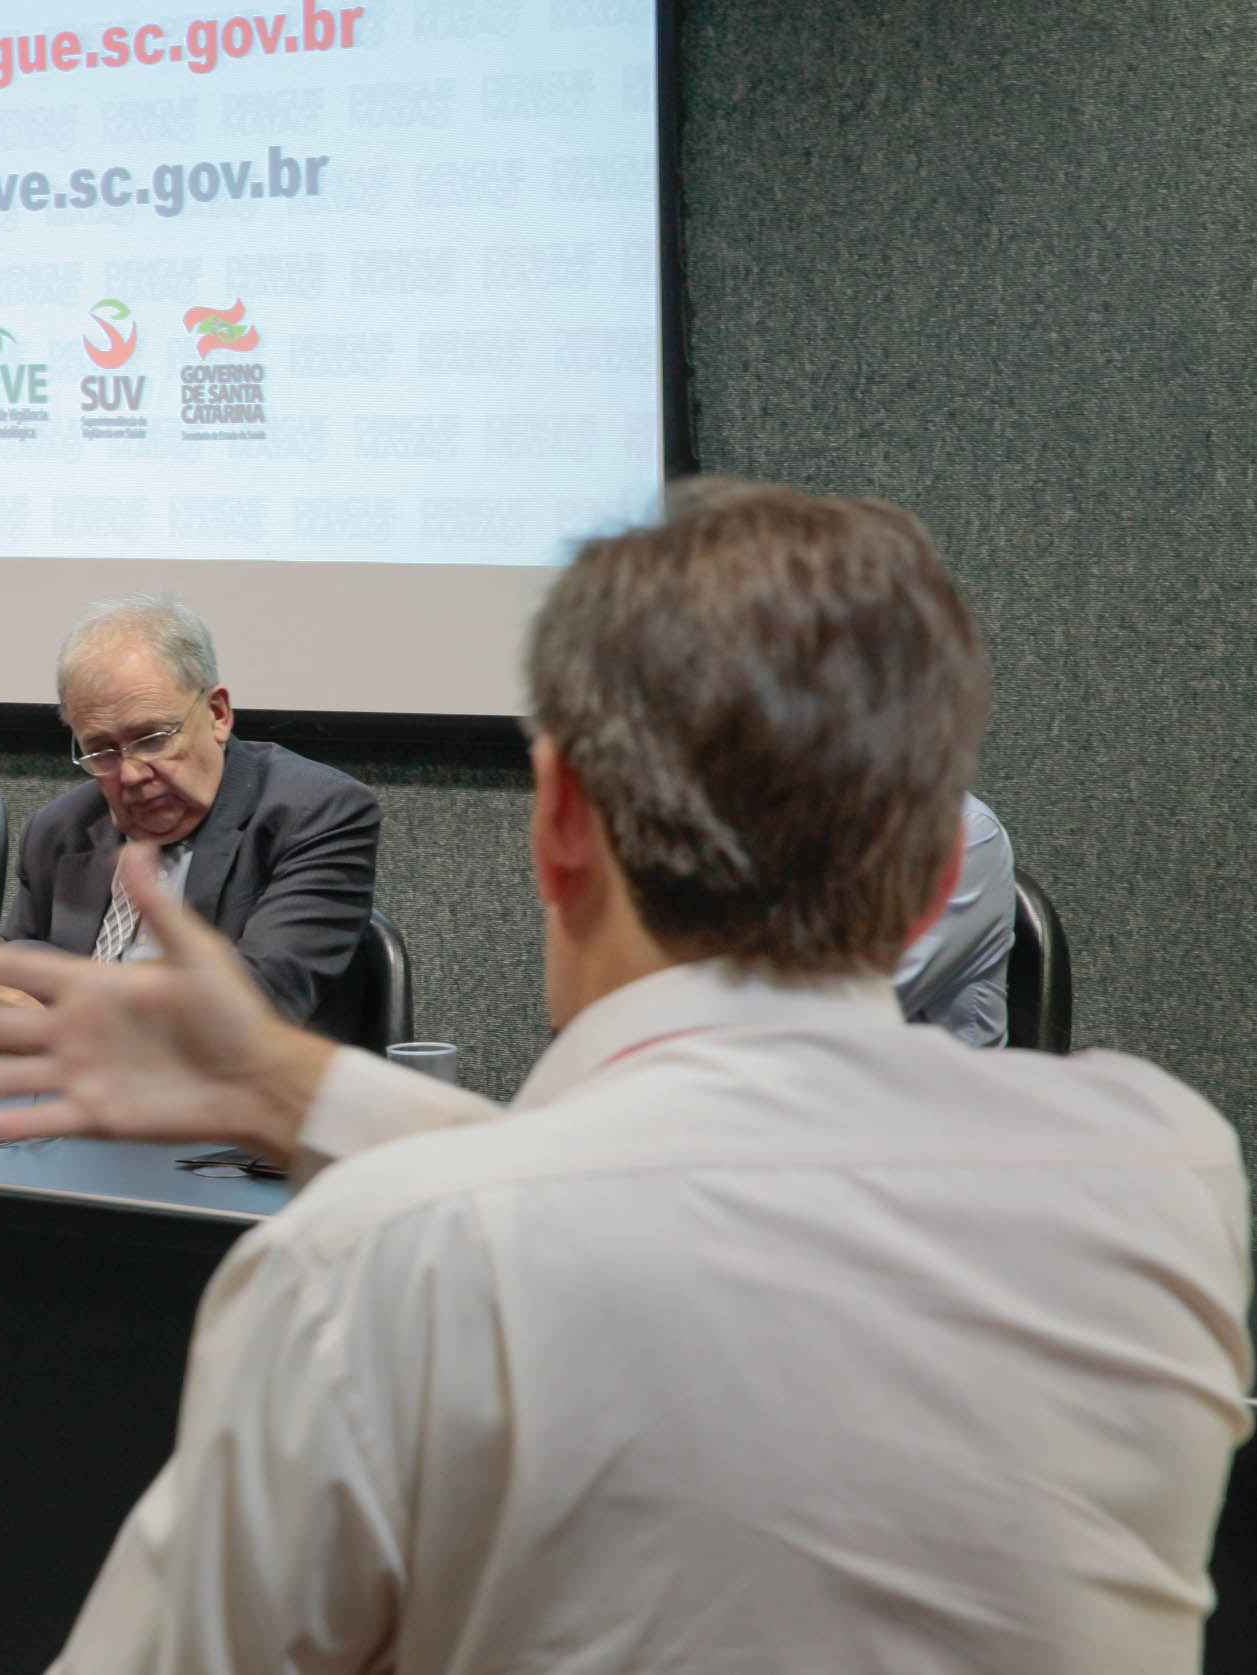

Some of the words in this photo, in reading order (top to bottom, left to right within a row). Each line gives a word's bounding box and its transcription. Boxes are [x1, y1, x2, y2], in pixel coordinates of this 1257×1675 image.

[181, 364, 264, 383] GOVERNO
[81, 375, 146, 411] SUV
[181, 385, 206, 403] DE
[208, 384, 263, 403] SANTA
[181, 404, 265, 424] CATARINA
